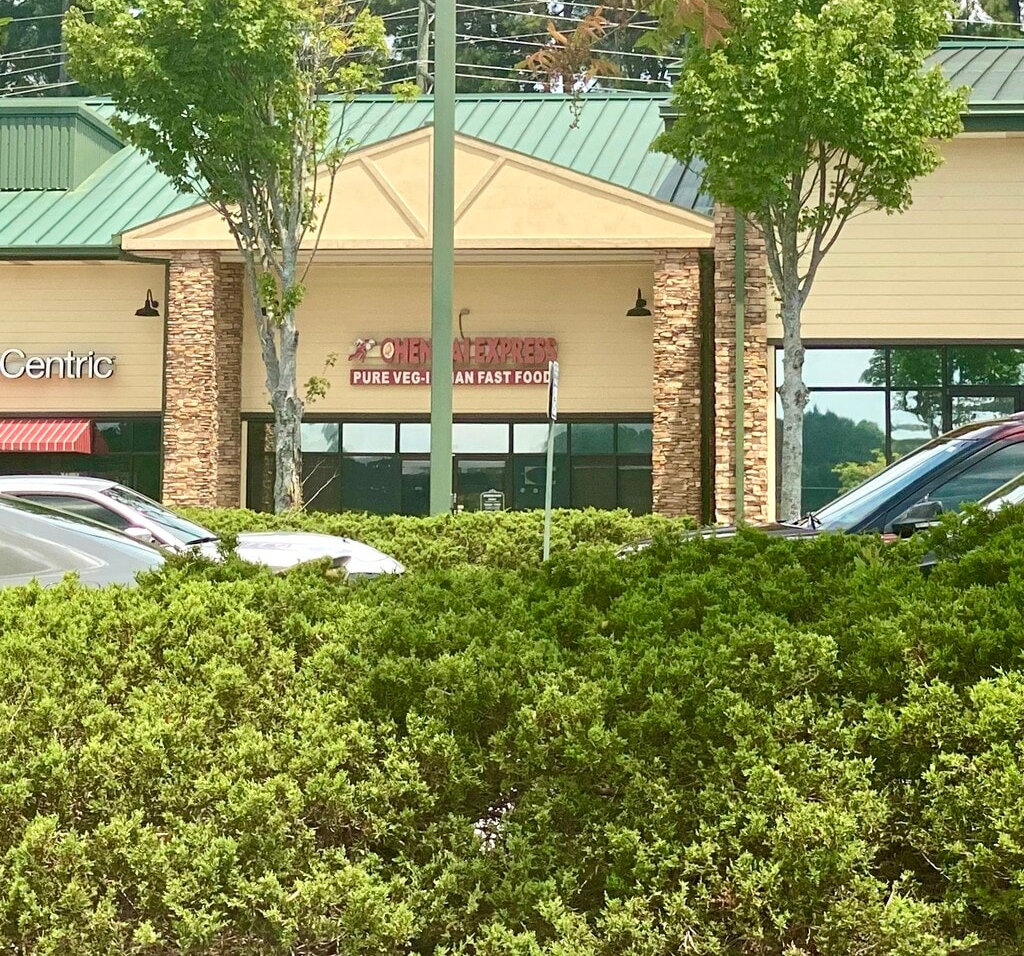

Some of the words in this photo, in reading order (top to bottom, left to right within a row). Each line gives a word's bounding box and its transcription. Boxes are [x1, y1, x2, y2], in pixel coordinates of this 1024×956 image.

[474, 337, 558, 364] EXPRESS
[353, 371, 390, 384] PURE
[392, 370, 474, 384] VEG-IIAN
[477, 370, 512, 384] FAST
[514, 370, 551, 384] FOOD
